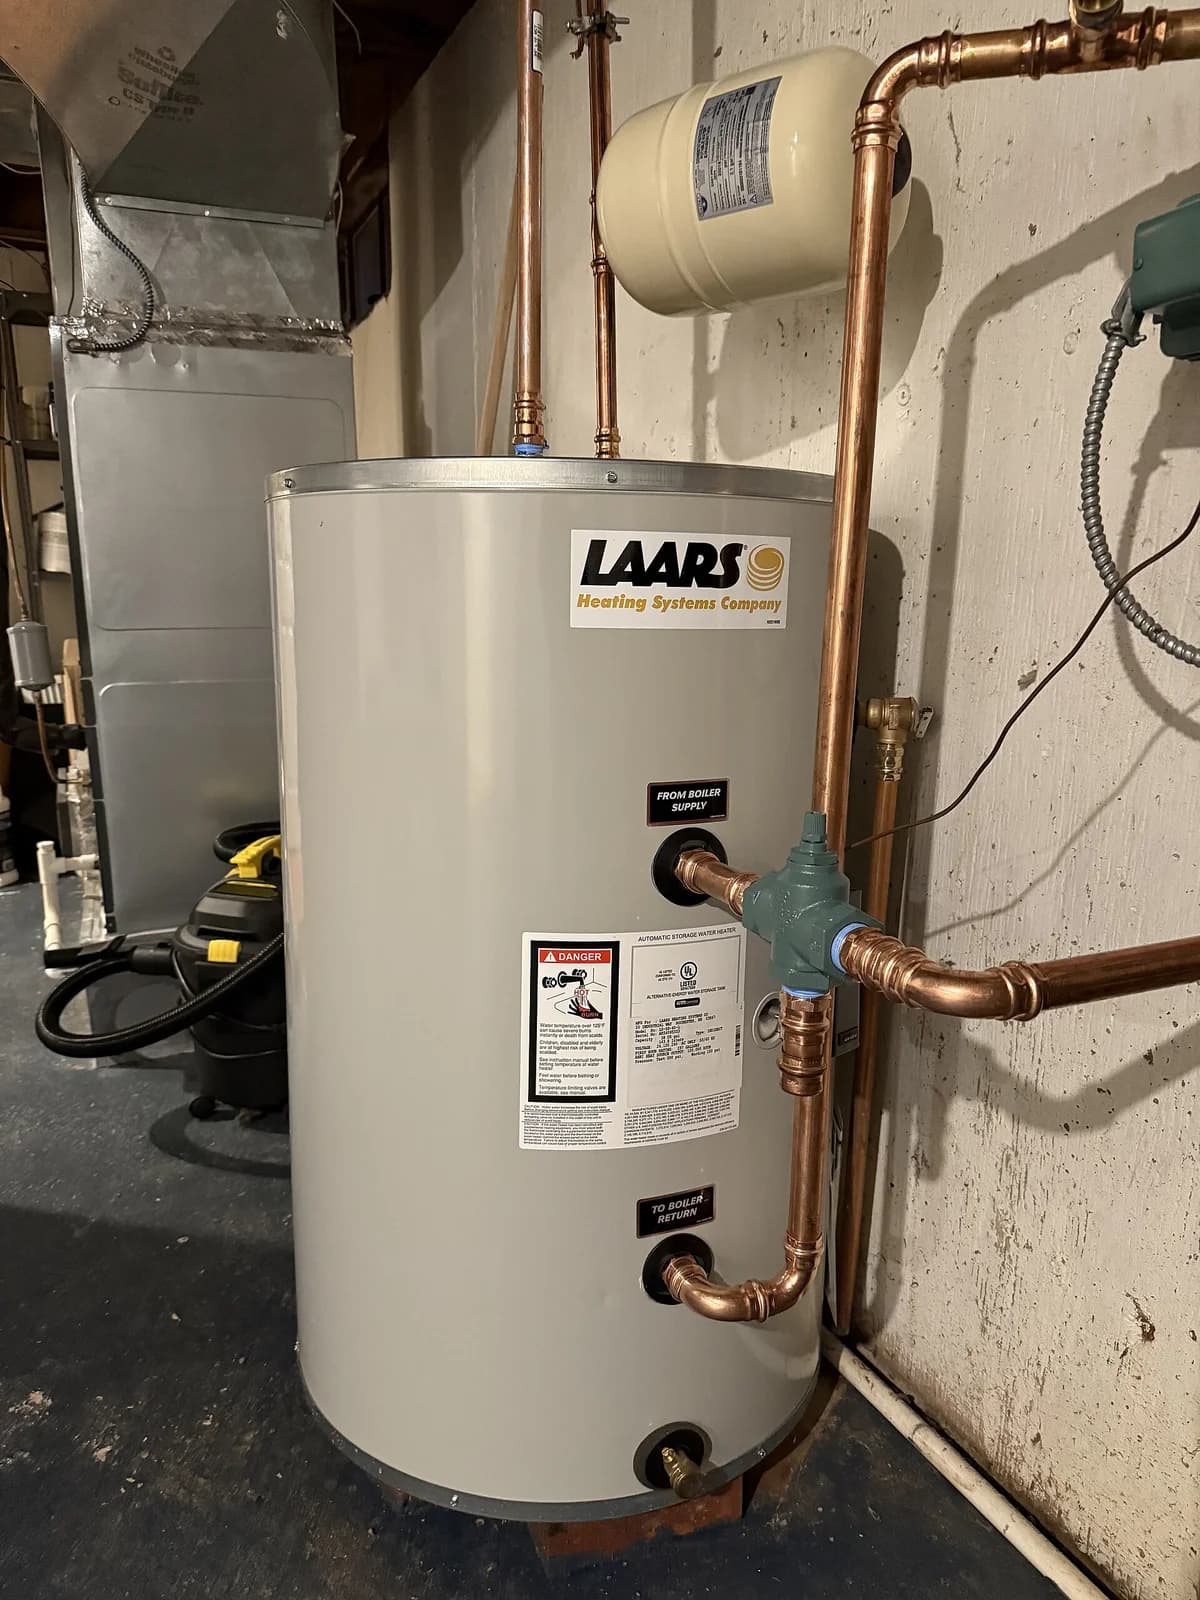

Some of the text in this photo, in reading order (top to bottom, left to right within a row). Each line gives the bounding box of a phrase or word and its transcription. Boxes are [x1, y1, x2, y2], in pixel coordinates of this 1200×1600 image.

[580, 539, 743, 588] LAARS
[577, 594, 782, 613] Heating Systems Company
[657, 788, 721, 800] FROM BOILER
[672, 801, 707, 811] SUPPLY
[559, 953, 602, 961] DANGER
[652, 1194, 703, 1214] TO BOILER
[657, 1208, 697, 1224] RETURN
